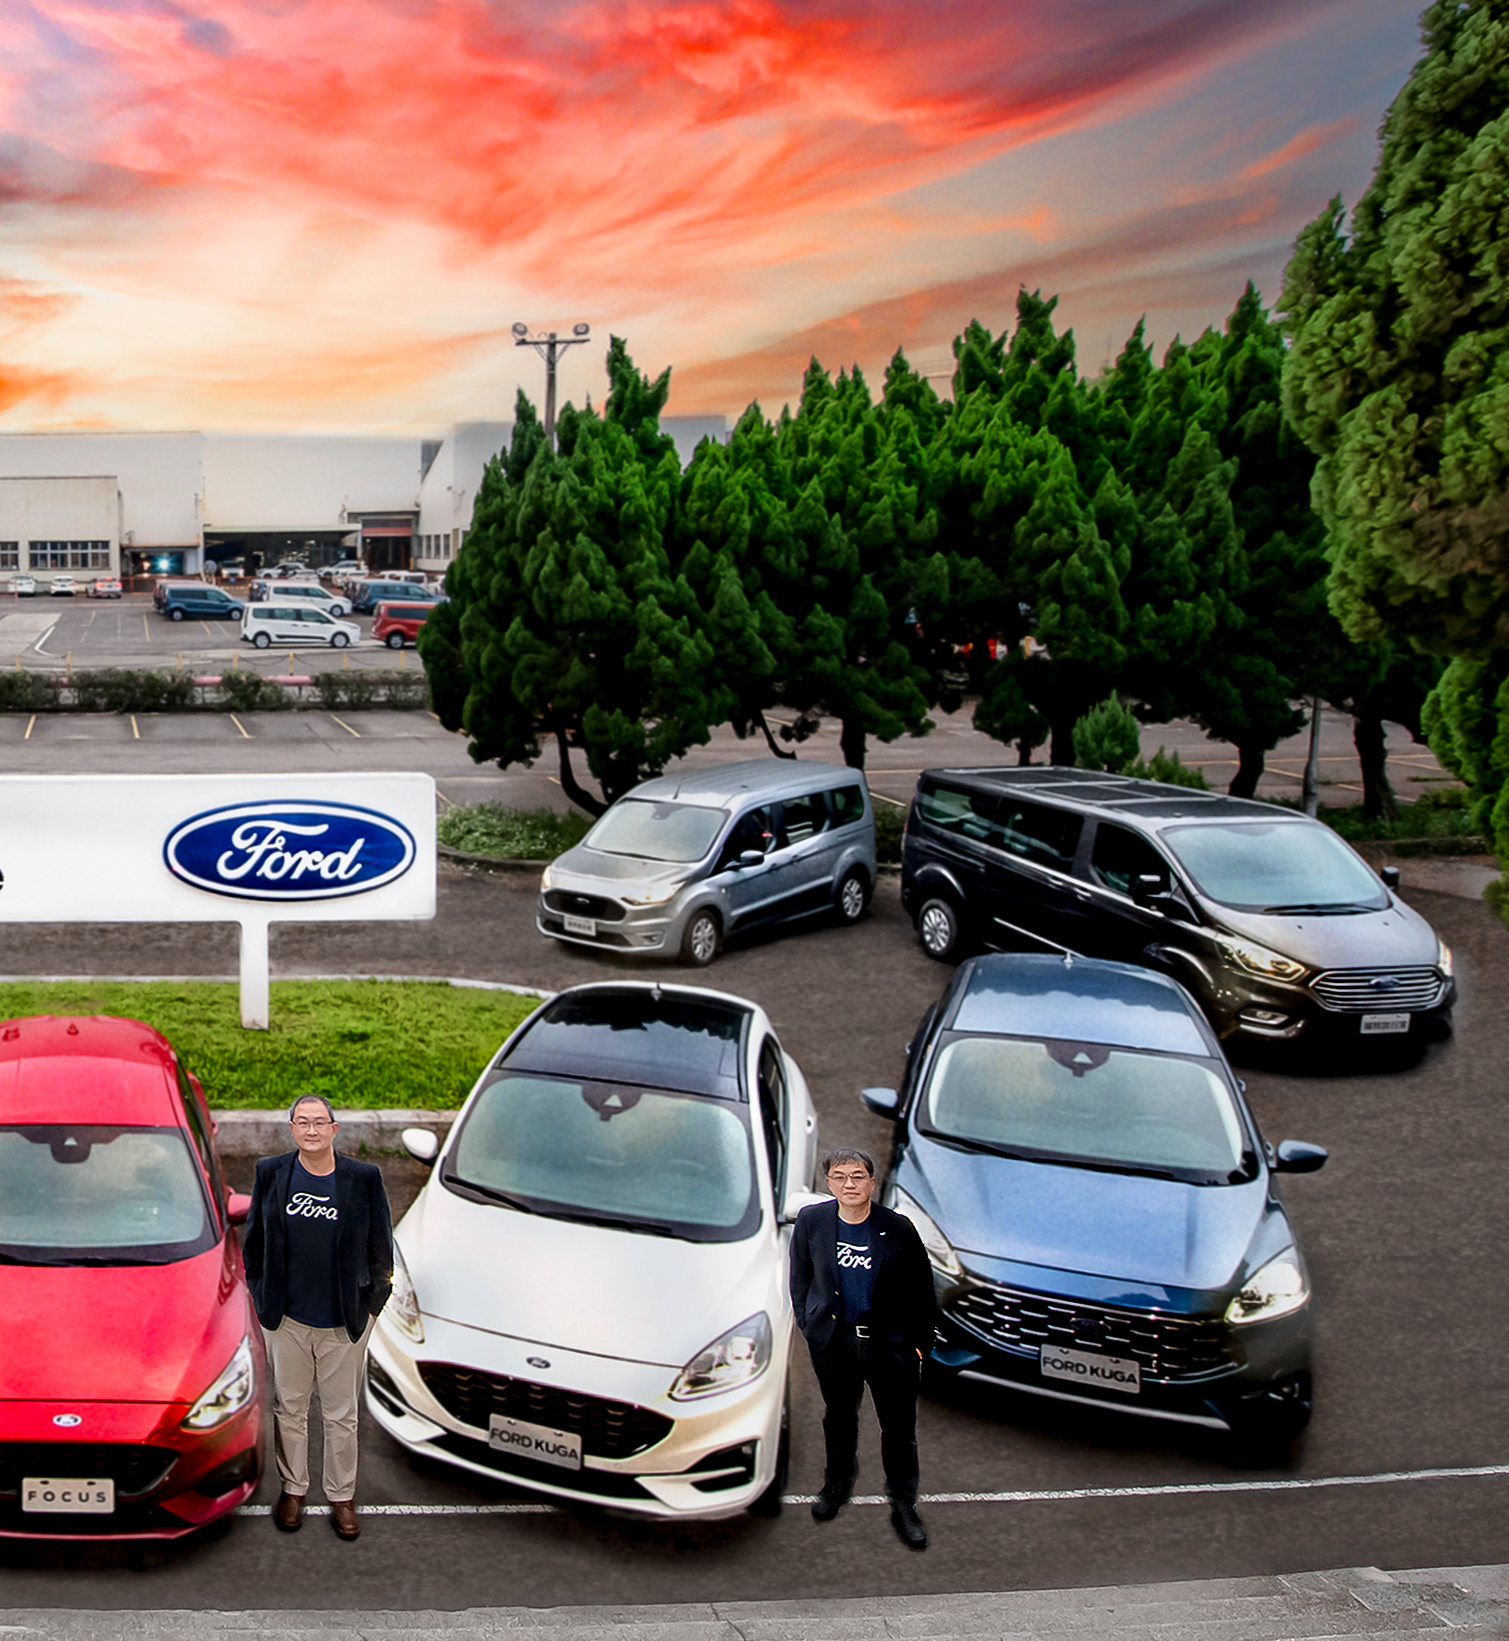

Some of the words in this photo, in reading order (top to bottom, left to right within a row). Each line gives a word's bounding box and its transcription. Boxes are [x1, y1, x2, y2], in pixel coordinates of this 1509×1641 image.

[216, 819, 365, 880] Ford
[1042, 1356, 1088, 1375] FORD
[1090, 1365, 1138, 1385] KUGA
[490, 1427, 533, 1449] FORD
[535, 1438, 579, 1461] KUGA
[27, 1490, 107, 1503] FOCUS
